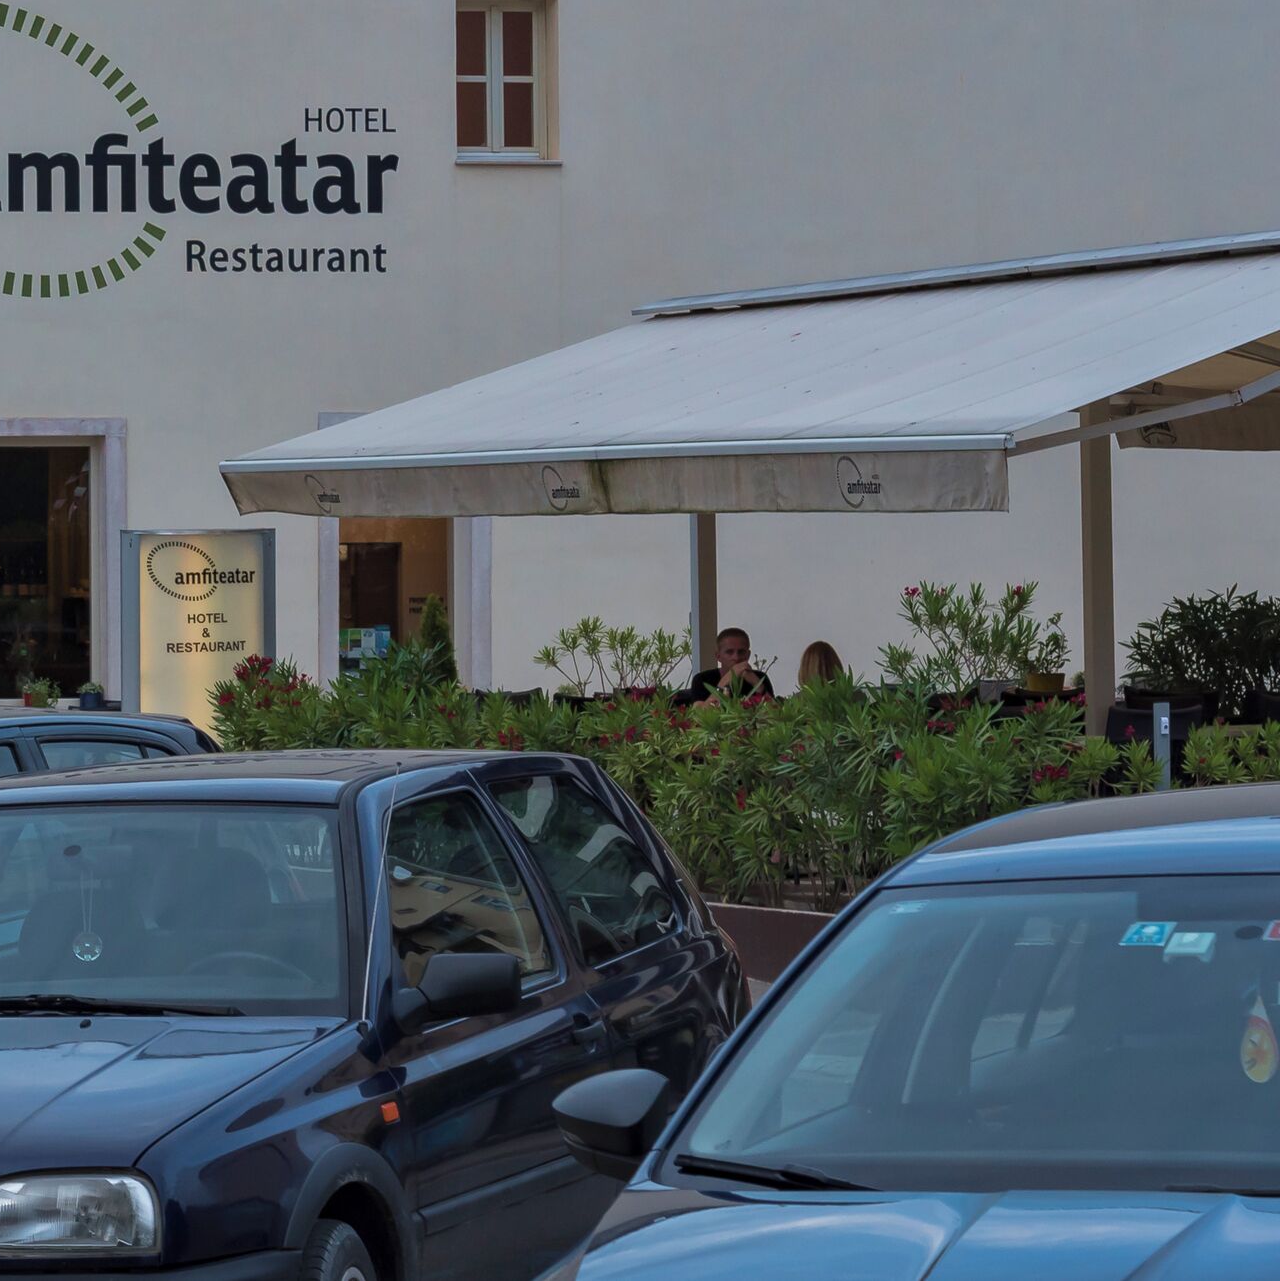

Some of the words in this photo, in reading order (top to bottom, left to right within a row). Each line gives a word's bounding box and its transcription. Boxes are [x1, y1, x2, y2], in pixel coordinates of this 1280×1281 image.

[304, 107, 397, 133] HOTEL
[186, 239, 388, 274] Restaurant
[175, 568, 256, 585] amfiteatar
[187, 613, 228, 624] HOTEL
[202, 627, 211, 638] &
[166, 640, 246, 653] RESTAURANT
